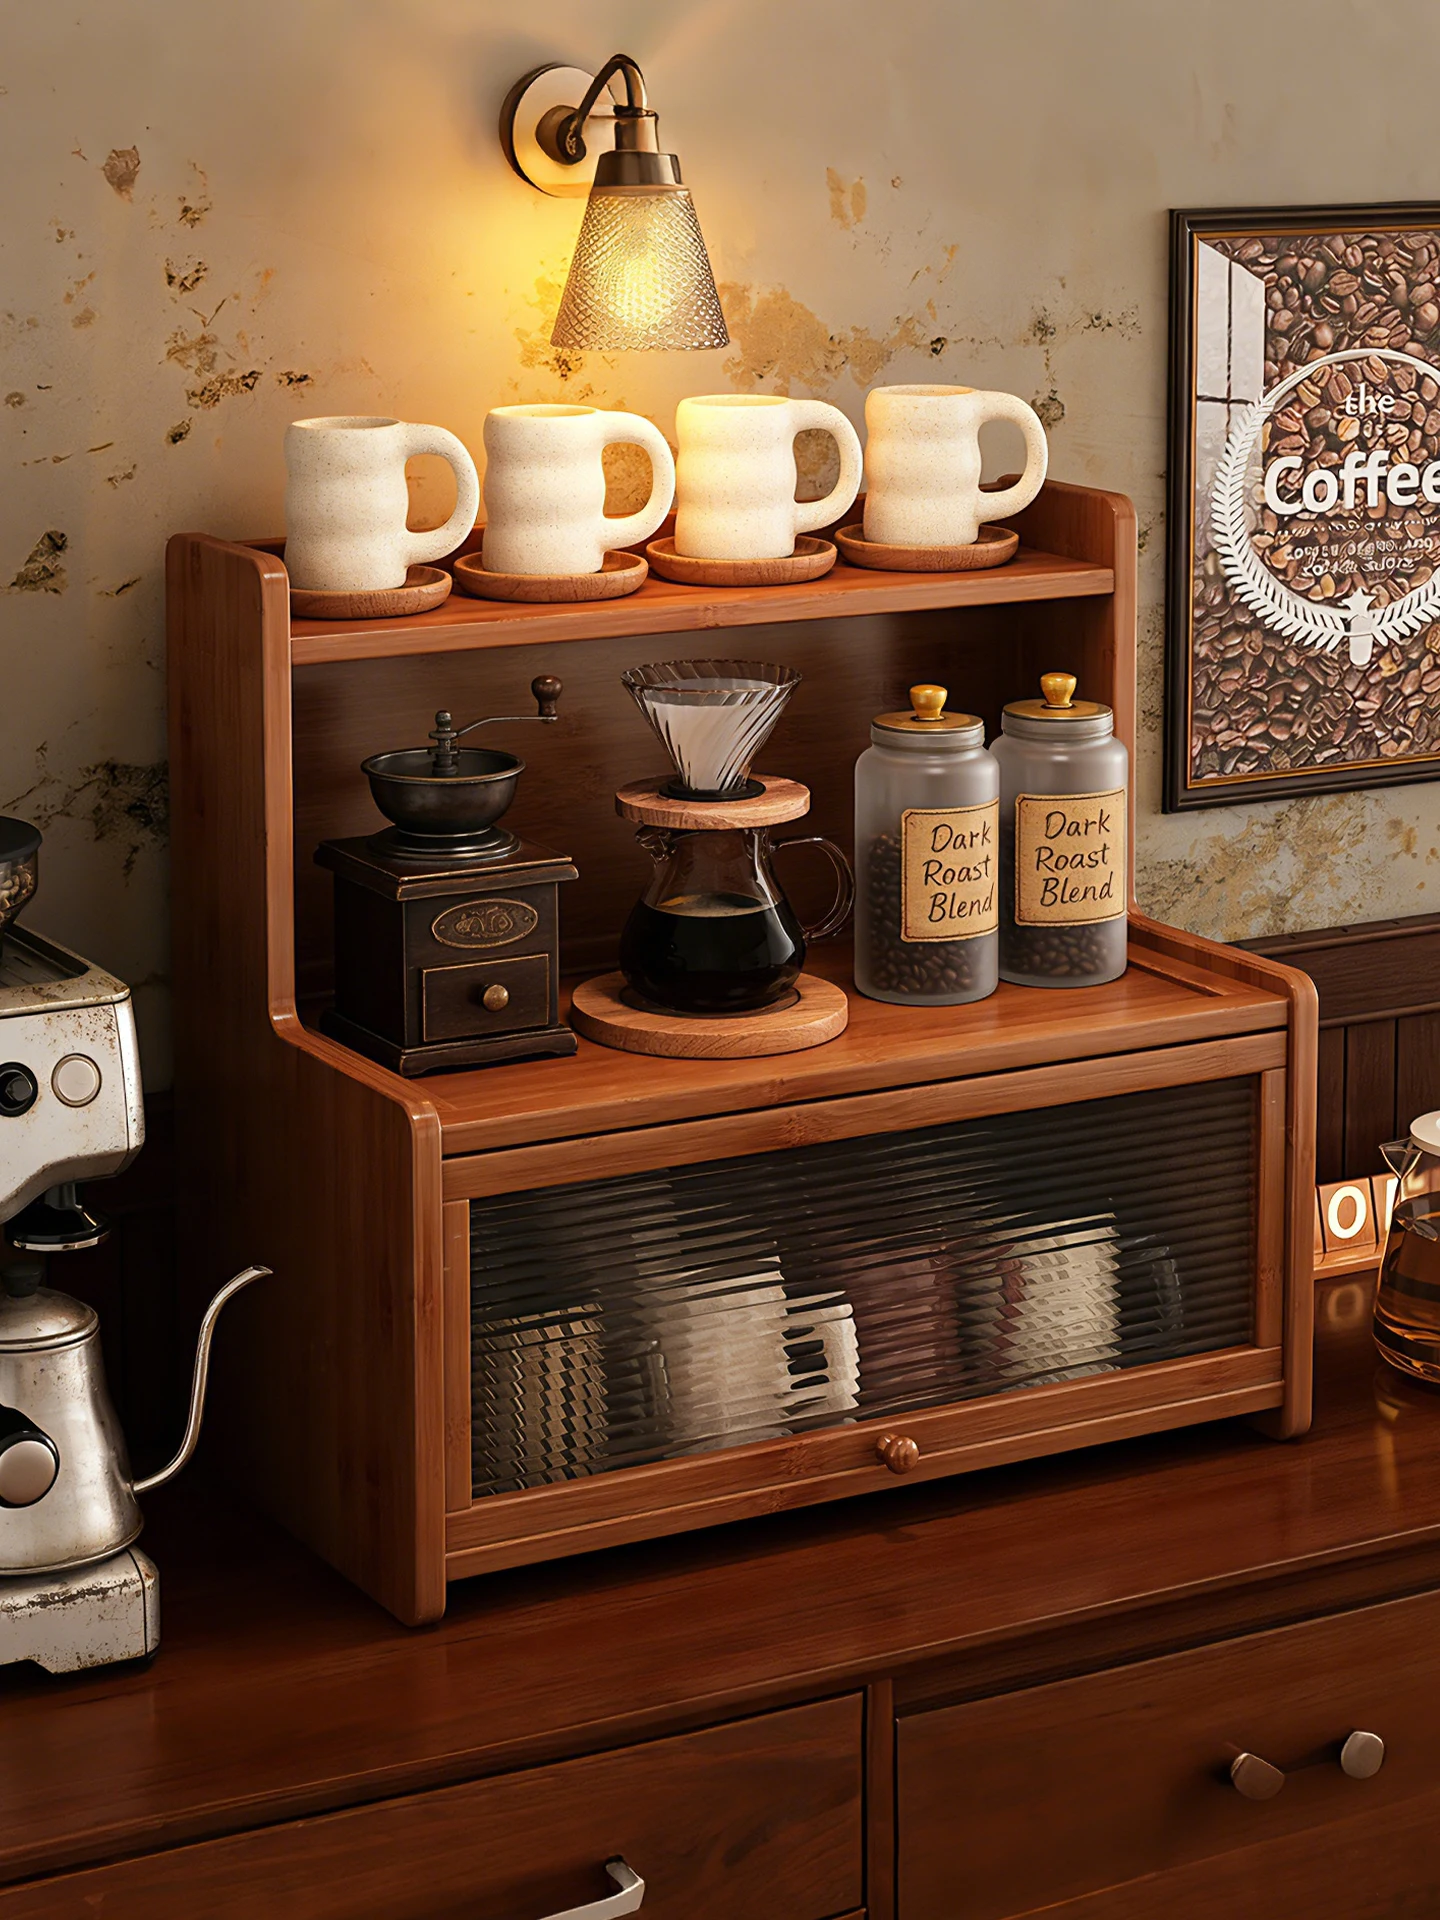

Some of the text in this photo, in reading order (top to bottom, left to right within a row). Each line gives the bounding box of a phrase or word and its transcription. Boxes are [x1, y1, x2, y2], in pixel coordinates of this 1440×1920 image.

[1345, 382, 1396, 416] the
[931, 821, 992, 853] Dark
[1044, 809, 1111, 840] Dark
[922, 854, 992, 886] Roast
[1035, 843, 1110, 872] Roast
[928, 882, 995, 923] Blend
[1040, 871, 1114, 907] Blend
